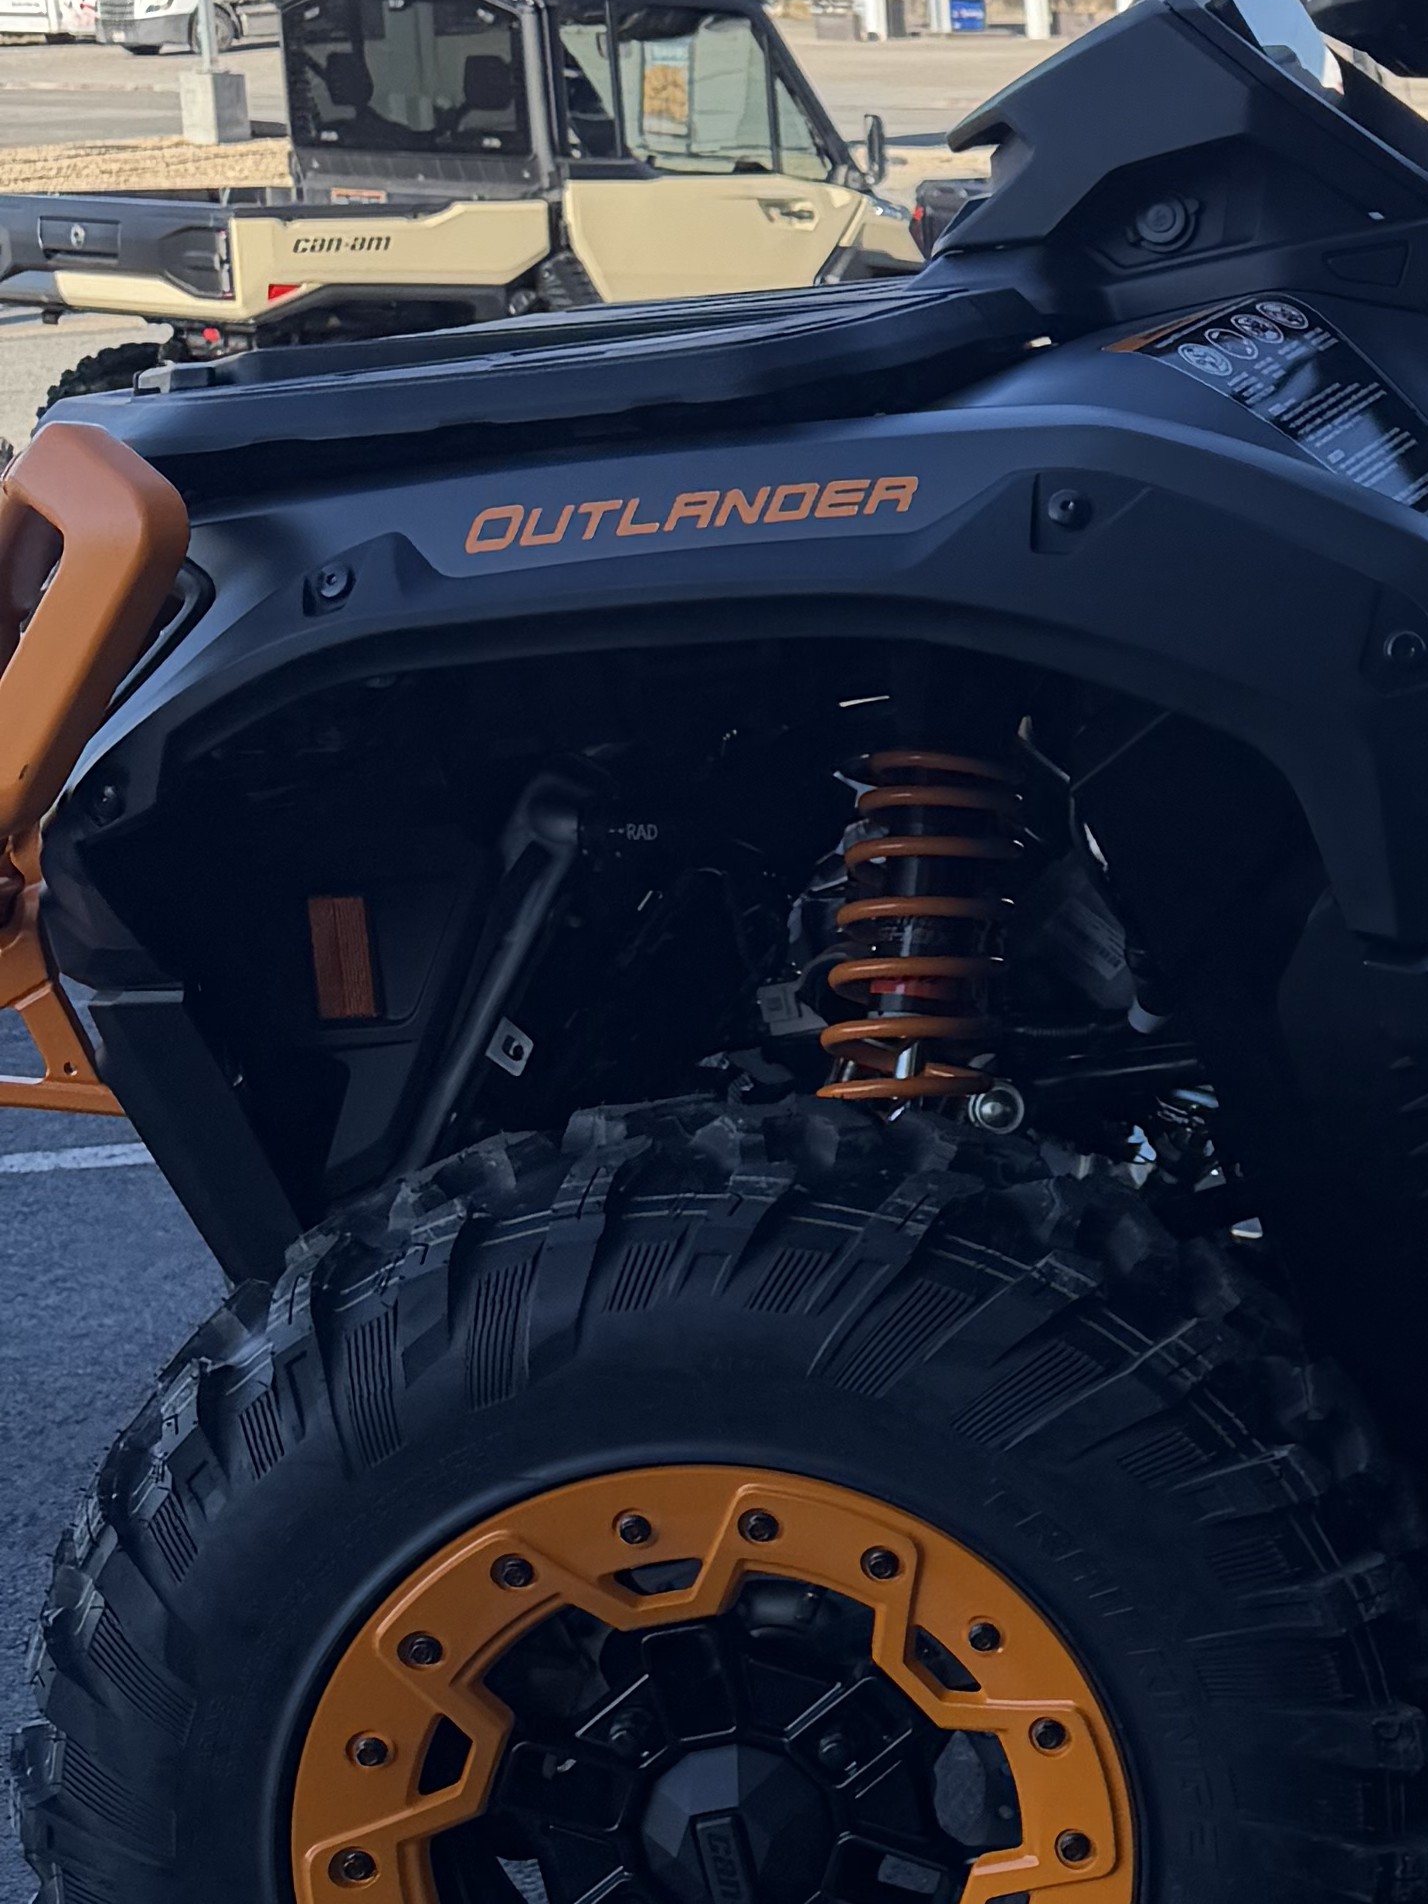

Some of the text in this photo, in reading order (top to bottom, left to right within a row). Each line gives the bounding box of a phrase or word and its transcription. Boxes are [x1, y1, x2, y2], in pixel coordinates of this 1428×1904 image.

[293, 236, 391, 253] can-am
[465, 476, 918, 554] OUTLANDER
[626, 823, 659, 840] RAD
